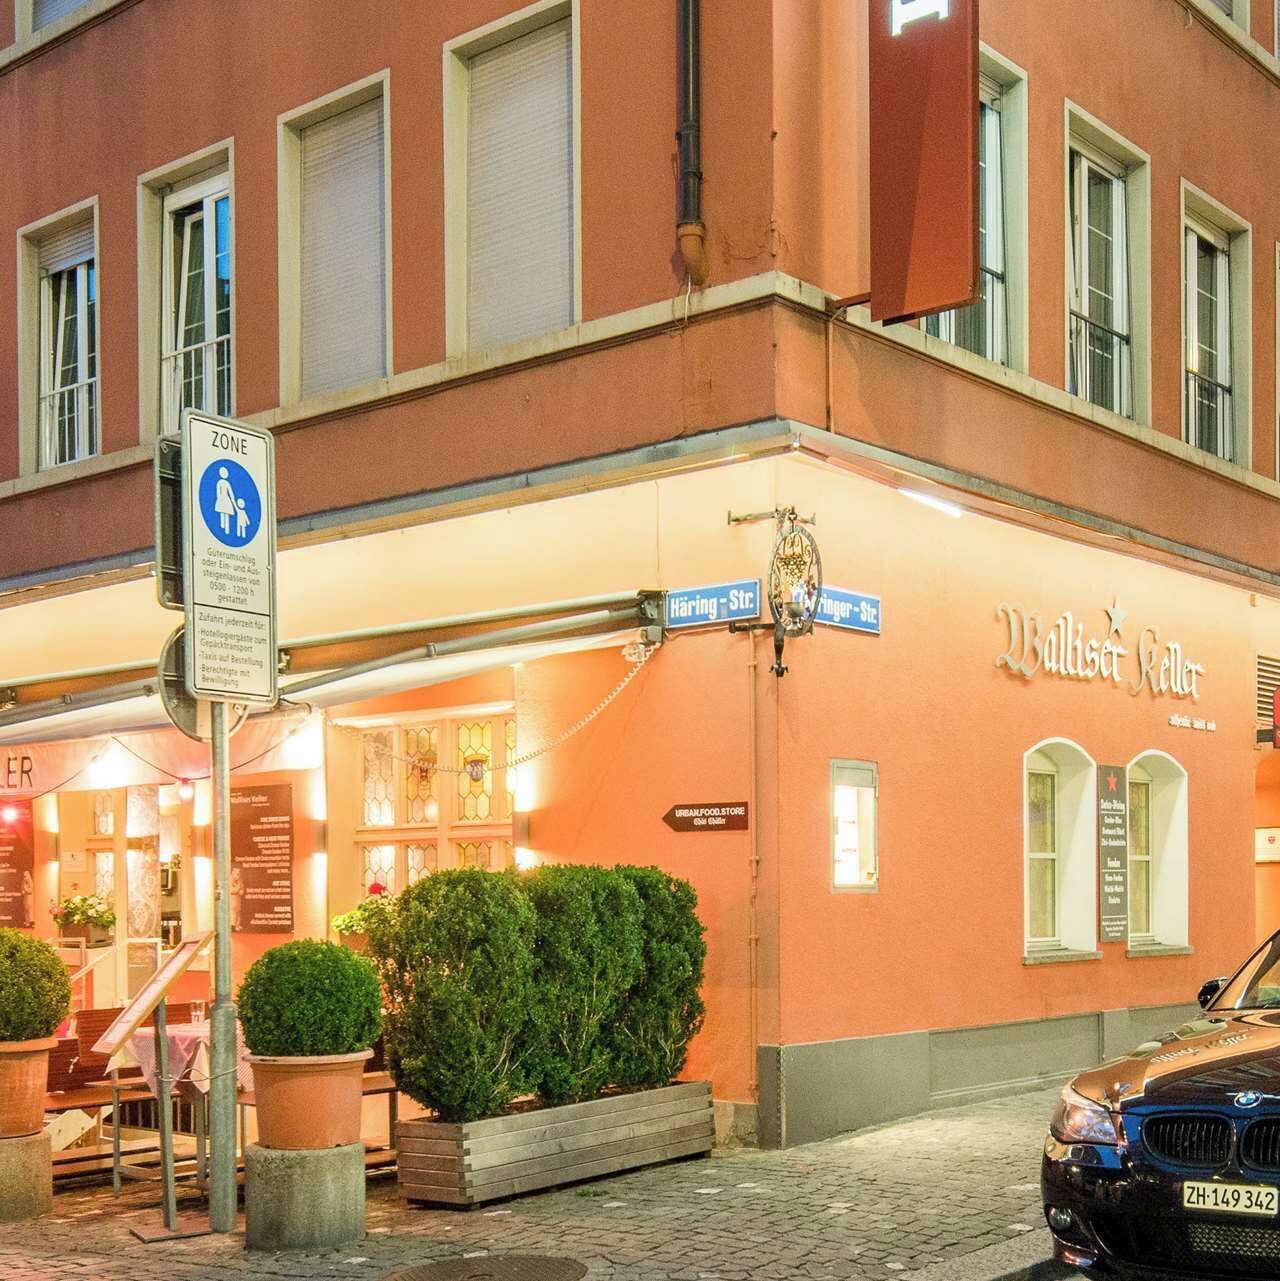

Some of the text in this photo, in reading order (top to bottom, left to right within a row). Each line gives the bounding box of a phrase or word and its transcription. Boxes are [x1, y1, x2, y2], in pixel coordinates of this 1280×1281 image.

[211, 431, 248, 455] ZONE
[995, 602, 1206, 699] Walliser Keller
[675, 807, 745, 817] URBAN.FOOD.STORE
[1244, 1190, 1275, 1211] 342
